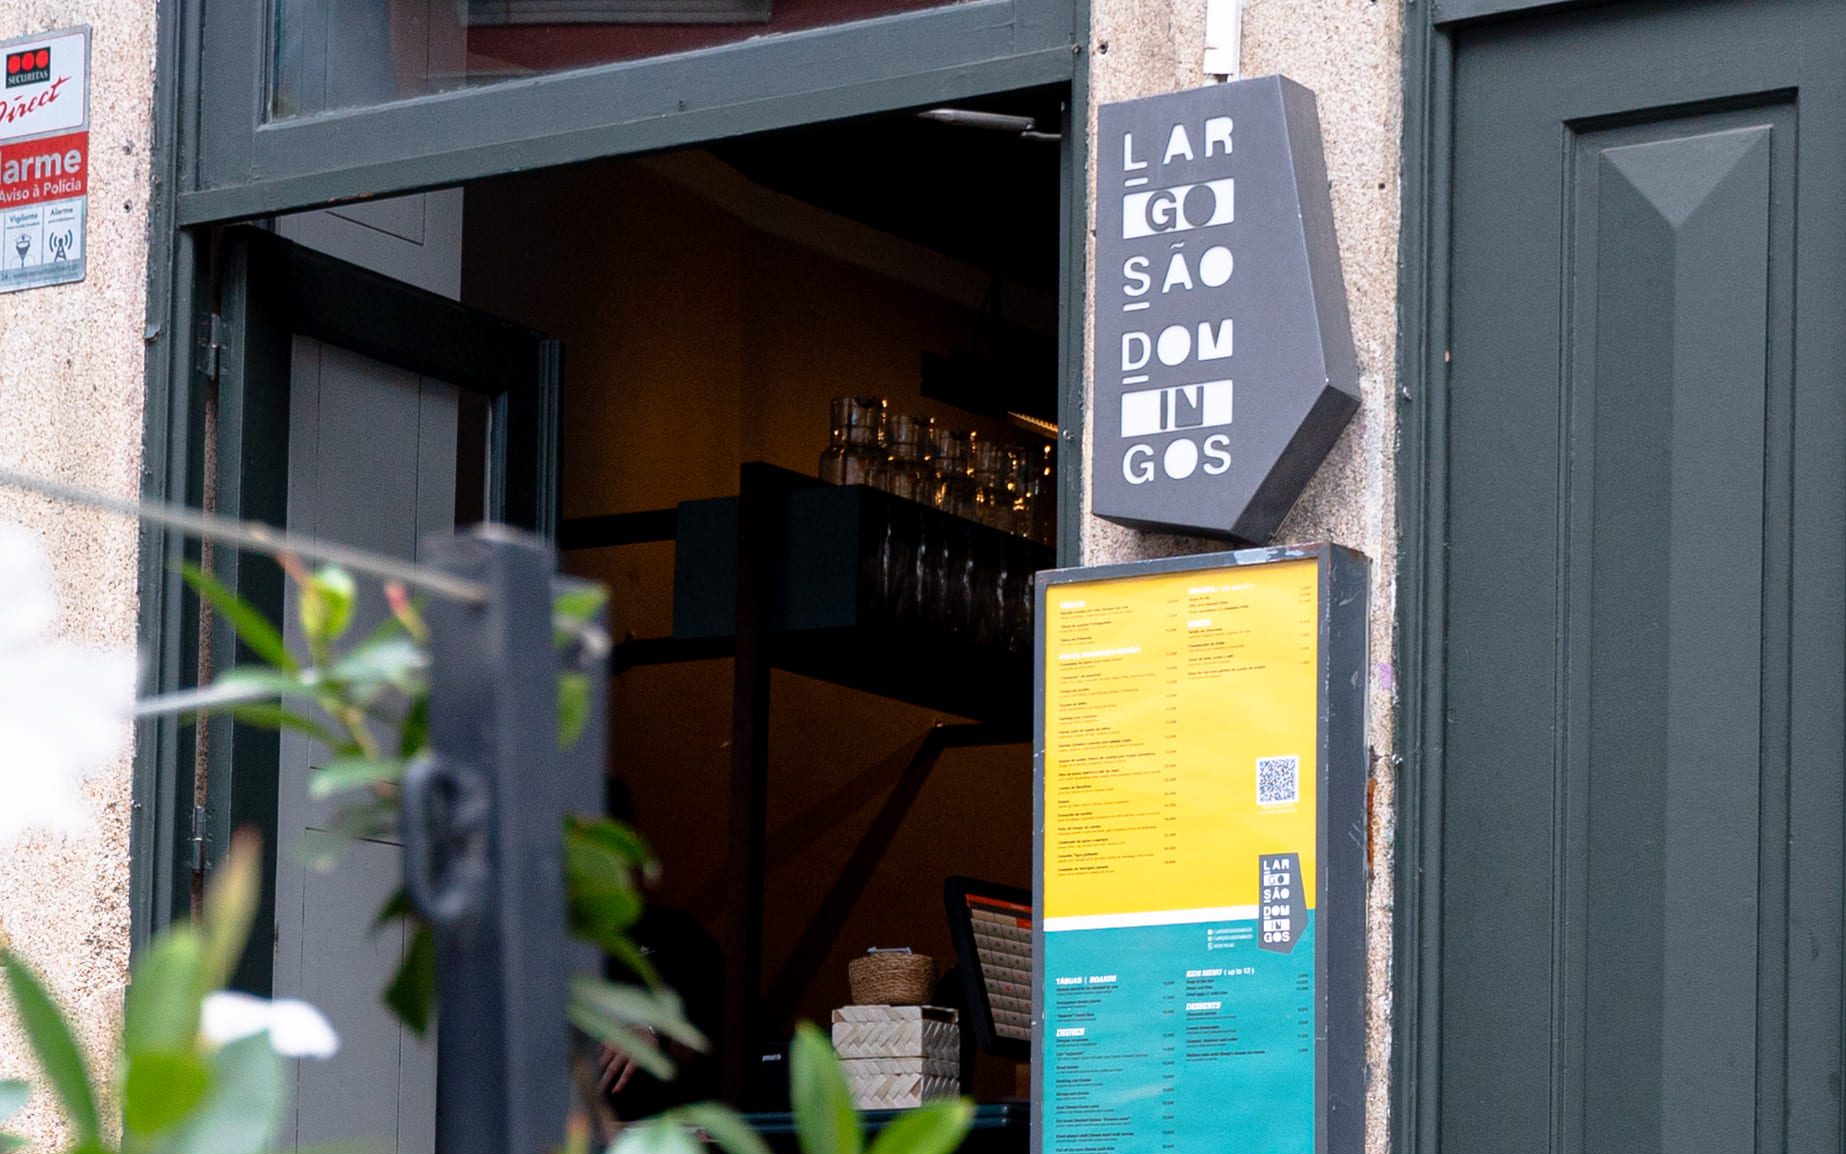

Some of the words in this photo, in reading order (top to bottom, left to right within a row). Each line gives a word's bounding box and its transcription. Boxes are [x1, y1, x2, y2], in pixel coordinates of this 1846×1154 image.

[8, 69, 49, 86] SECURITAS
[1123, 116, 1234, 172] LAR
[32, 183, 40, 198] à
[43, 178, 82, 196] Polícia
[50, 206, 73, 217] Alarme
[1145, 184, 1217, 232] GO
[1122, 241, 1234, 297] SÃO
[1121, 318, 1233, 372] DOM
[1122, 434, 1232, 485] GOS
[1263, 859, 1290, 870] LAR
[1263, 905, 1290, 916] DOM
[1263, 931, 1290, 943] GOS
